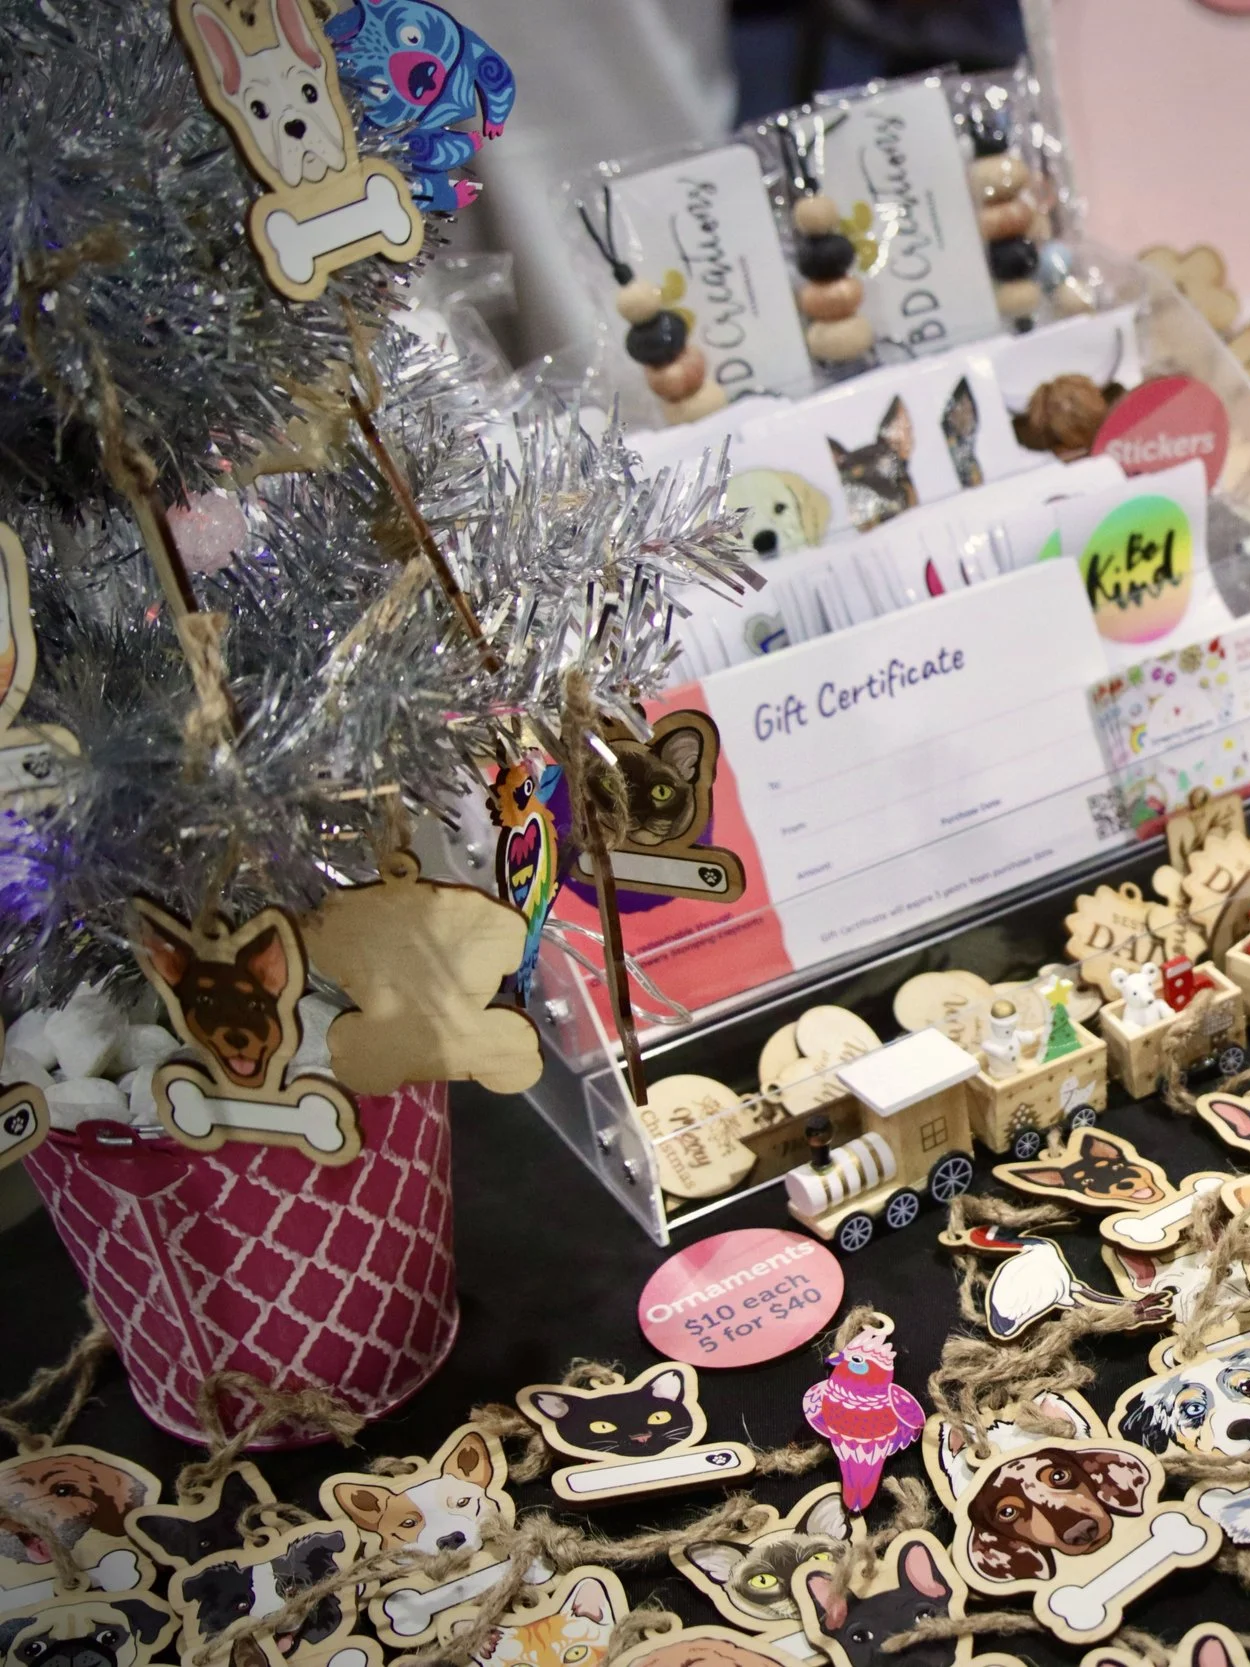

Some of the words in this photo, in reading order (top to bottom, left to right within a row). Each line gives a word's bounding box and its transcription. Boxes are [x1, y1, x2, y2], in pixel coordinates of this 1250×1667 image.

[1106, 431, 1215, 464] Stickers
[1086, 530, 1182, 614] Kind
[1126, 533, 1160, 571] Be
[755, 695, 807, 741] Gift
[818, 648, 966, 719] Certificate
[640, 1109, 697, 1190] Chrstmas
[646, 1241, 815, 1323] Ornaments
[685, 1304, 735, 1336] $10
[743, 1274, 810, 1309] each
[699, 1336, 718, 1353] 5
[723, 1316, 763, 1342] for
[770, 1288, 821, 1320] $40
